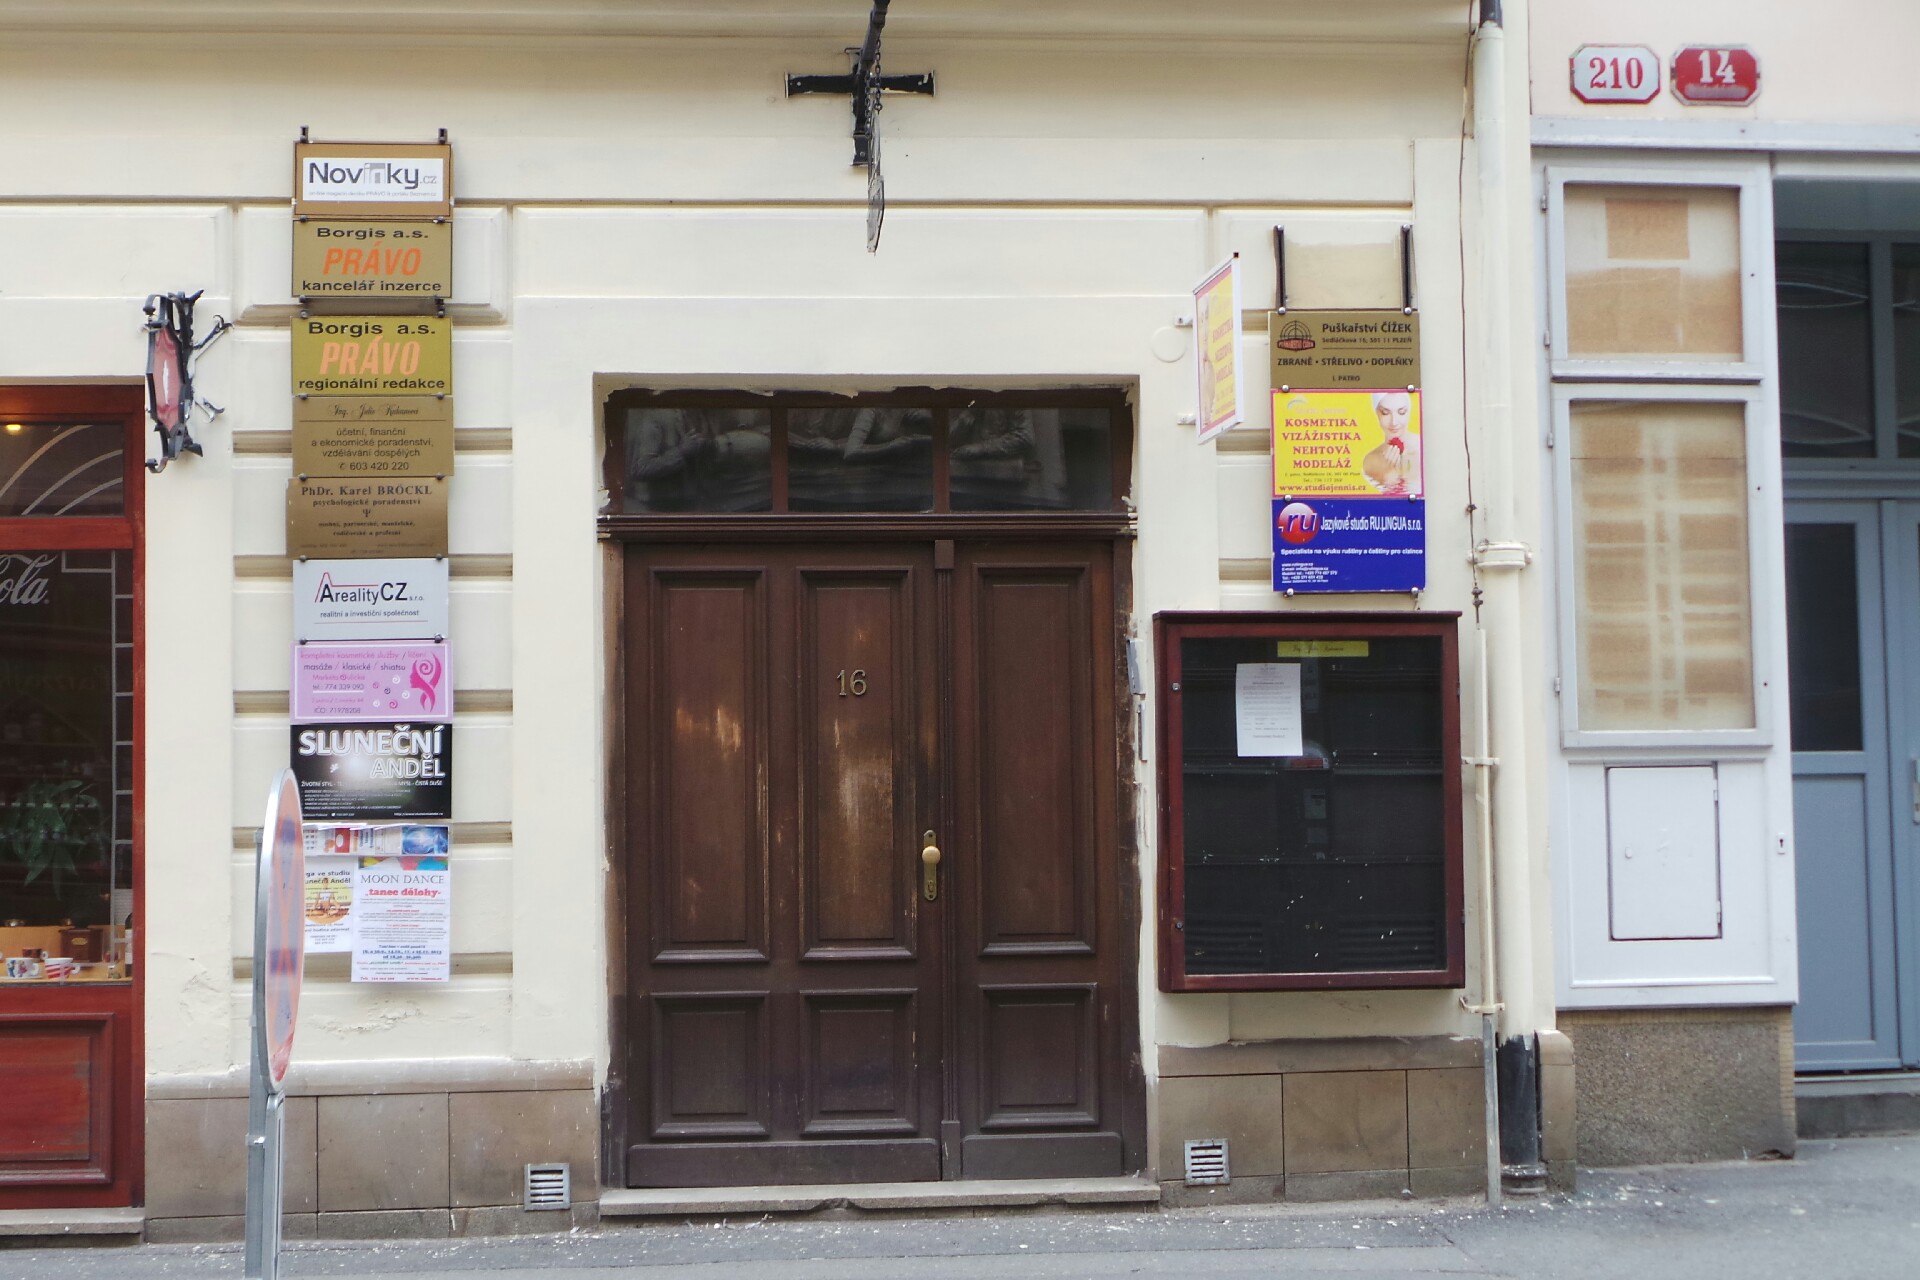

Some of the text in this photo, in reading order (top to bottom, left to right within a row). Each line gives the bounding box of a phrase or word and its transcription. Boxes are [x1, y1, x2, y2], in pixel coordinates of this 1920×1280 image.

[1699, 50, 1736, 84] 14
[1590, 58, 1644, 88] 210
[317, 228, 428, 240] Borgis a.s.
[322, 241, 422, 276] PRÁVO
[302, 280, 442, 291] kancelář inzerce
[308, 322, 436, 337] Borgis a.s.
[1322, 321, 1411, 333] Puškařství ČÍŽEK
[319, 336, 421, 376] PRÁVO
[1278, 357, 1414, 366] ZBRANĚ STŘELIVO DOPLŇKY
[299, 379, 445, 390] regionální redakce
[1285, 419, 1358, 427] KOSMETIKA
[1282, 430, 1361, 440] VIZÁŽISTIKA
[320, 438, 374, 447] ekonomické
[322, 448, 420, 458] vzdělávání dospělých
[1293, 444, 1351, 454] NEHTOVÁ
[350, 462, 409, 470] 603 420 220
[1293, 458, 1352, 468] MODELÁŽ
[302, 486, 334, 496] PhDr.
[340, 486, 372, 495] Karel
[313, 499, 369, 507] psychologické
[1321, 516, 1350, 534] Jazykové
[1350, 517, 1368, 530] studio
[1408, 520, 1422, 530] s.r.o.
[342, 662, 371, 670] klasické
[380, 662, 406, 670] shiatsu
[837, 670, 867, 696] 16
[299, 724, 444, 755] SLUNEČNÍ
[370, 754, 445, 778] ANDĚL
[360, 875, 444, 884] MOON DANCE
